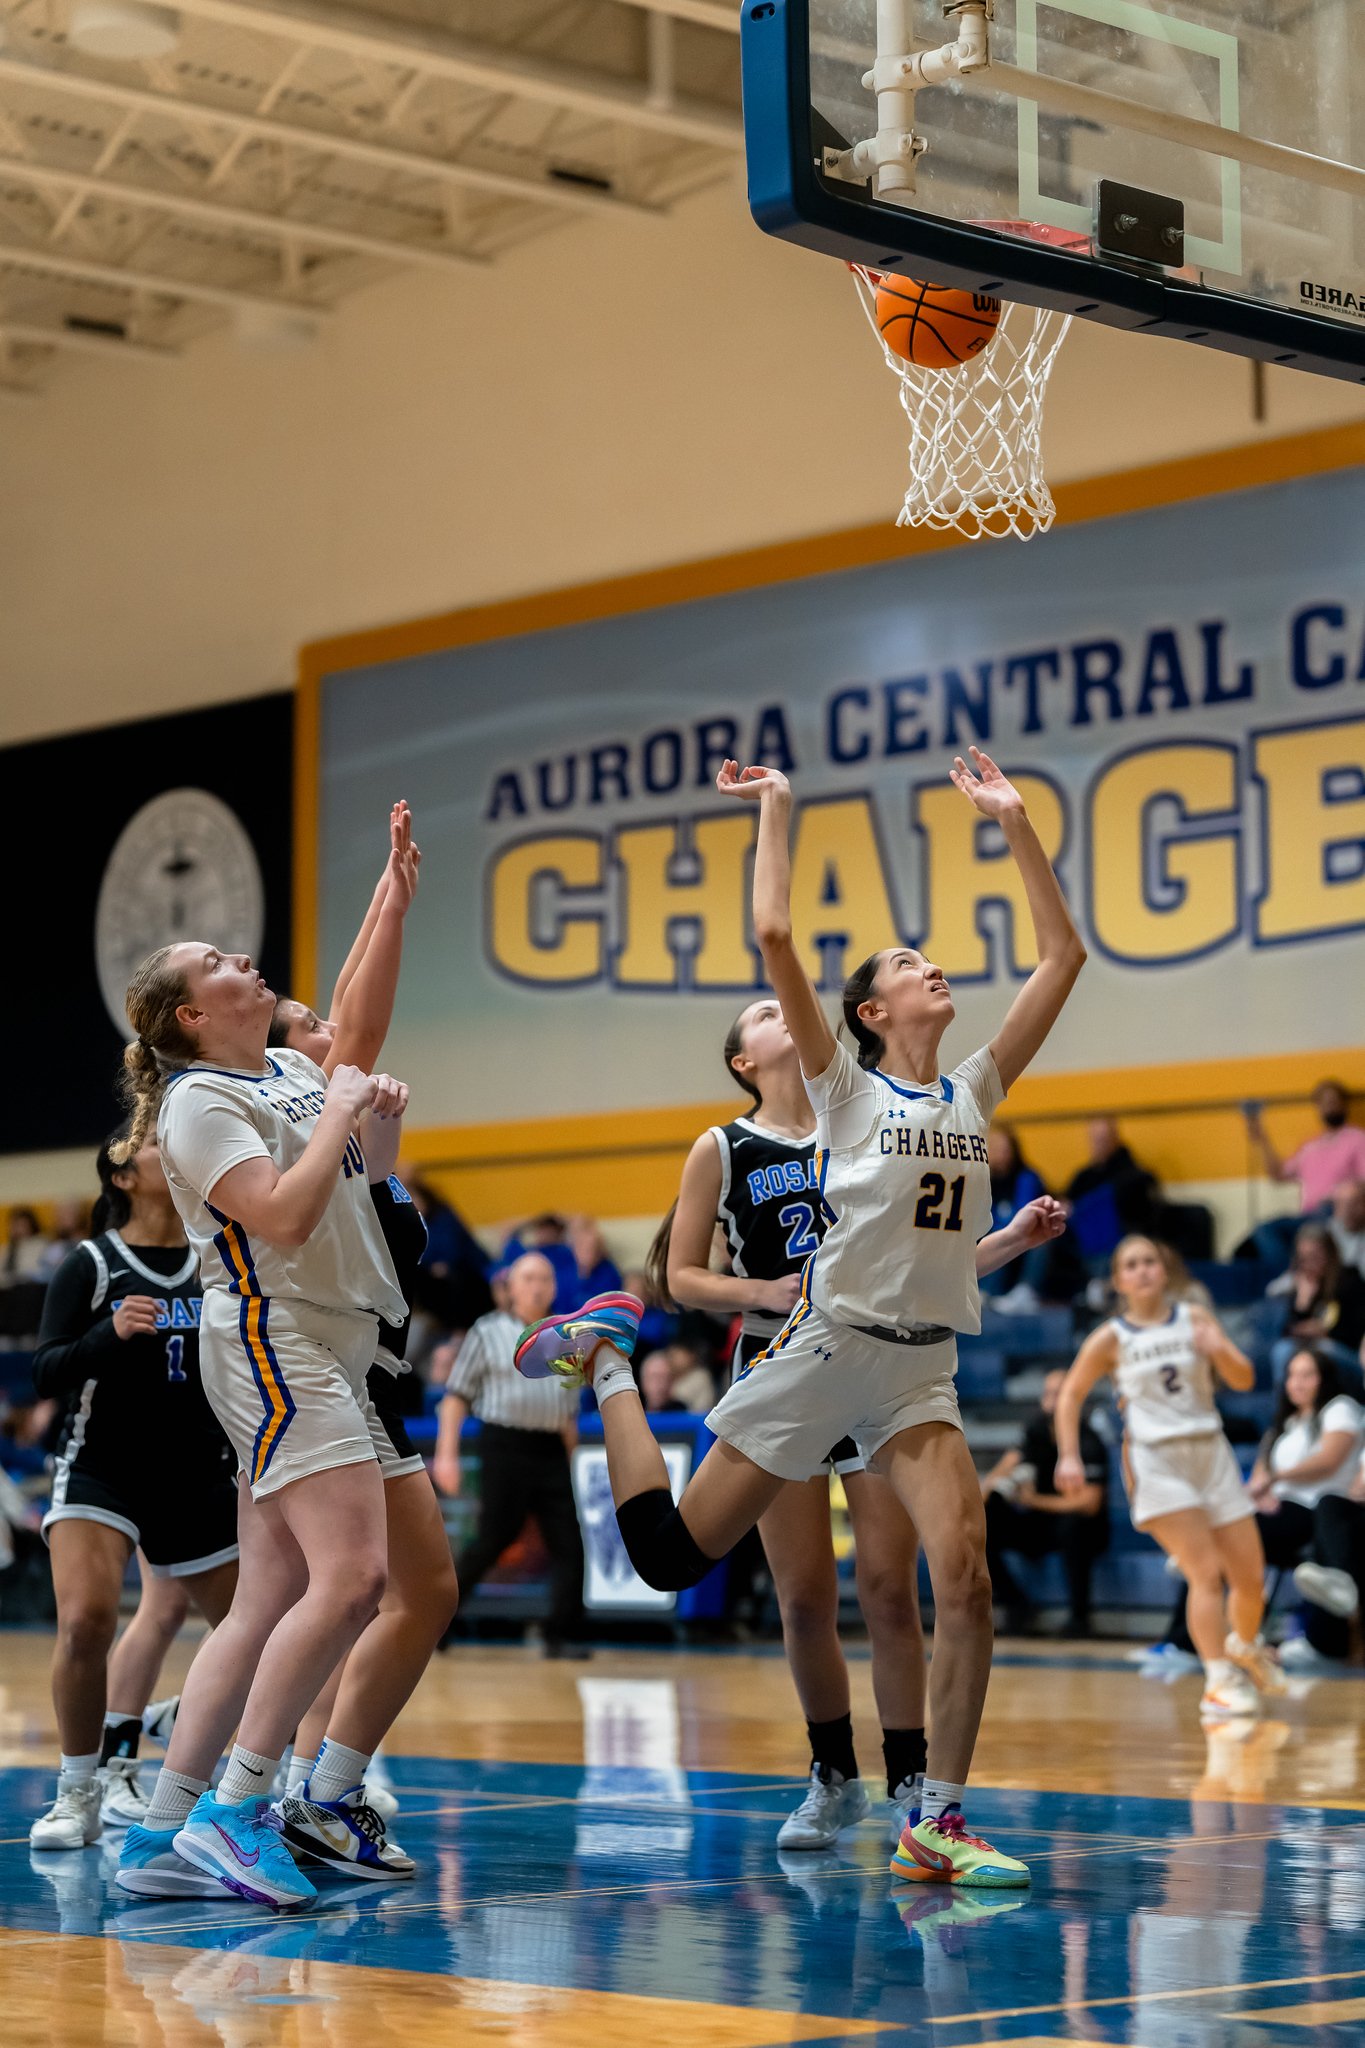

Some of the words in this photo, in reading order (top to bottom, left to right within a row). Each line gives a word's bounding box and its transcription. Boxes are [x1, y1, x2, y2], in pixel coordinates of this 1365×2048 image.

[487, 705, 796, 822] AURORA
[826, 619, 1254, 764] CENTRAL
[914, 1172, 966, 1232] 21
[165, 1335, 187, 1381] 1
[1160, 1364, 1182, 1395] 2
